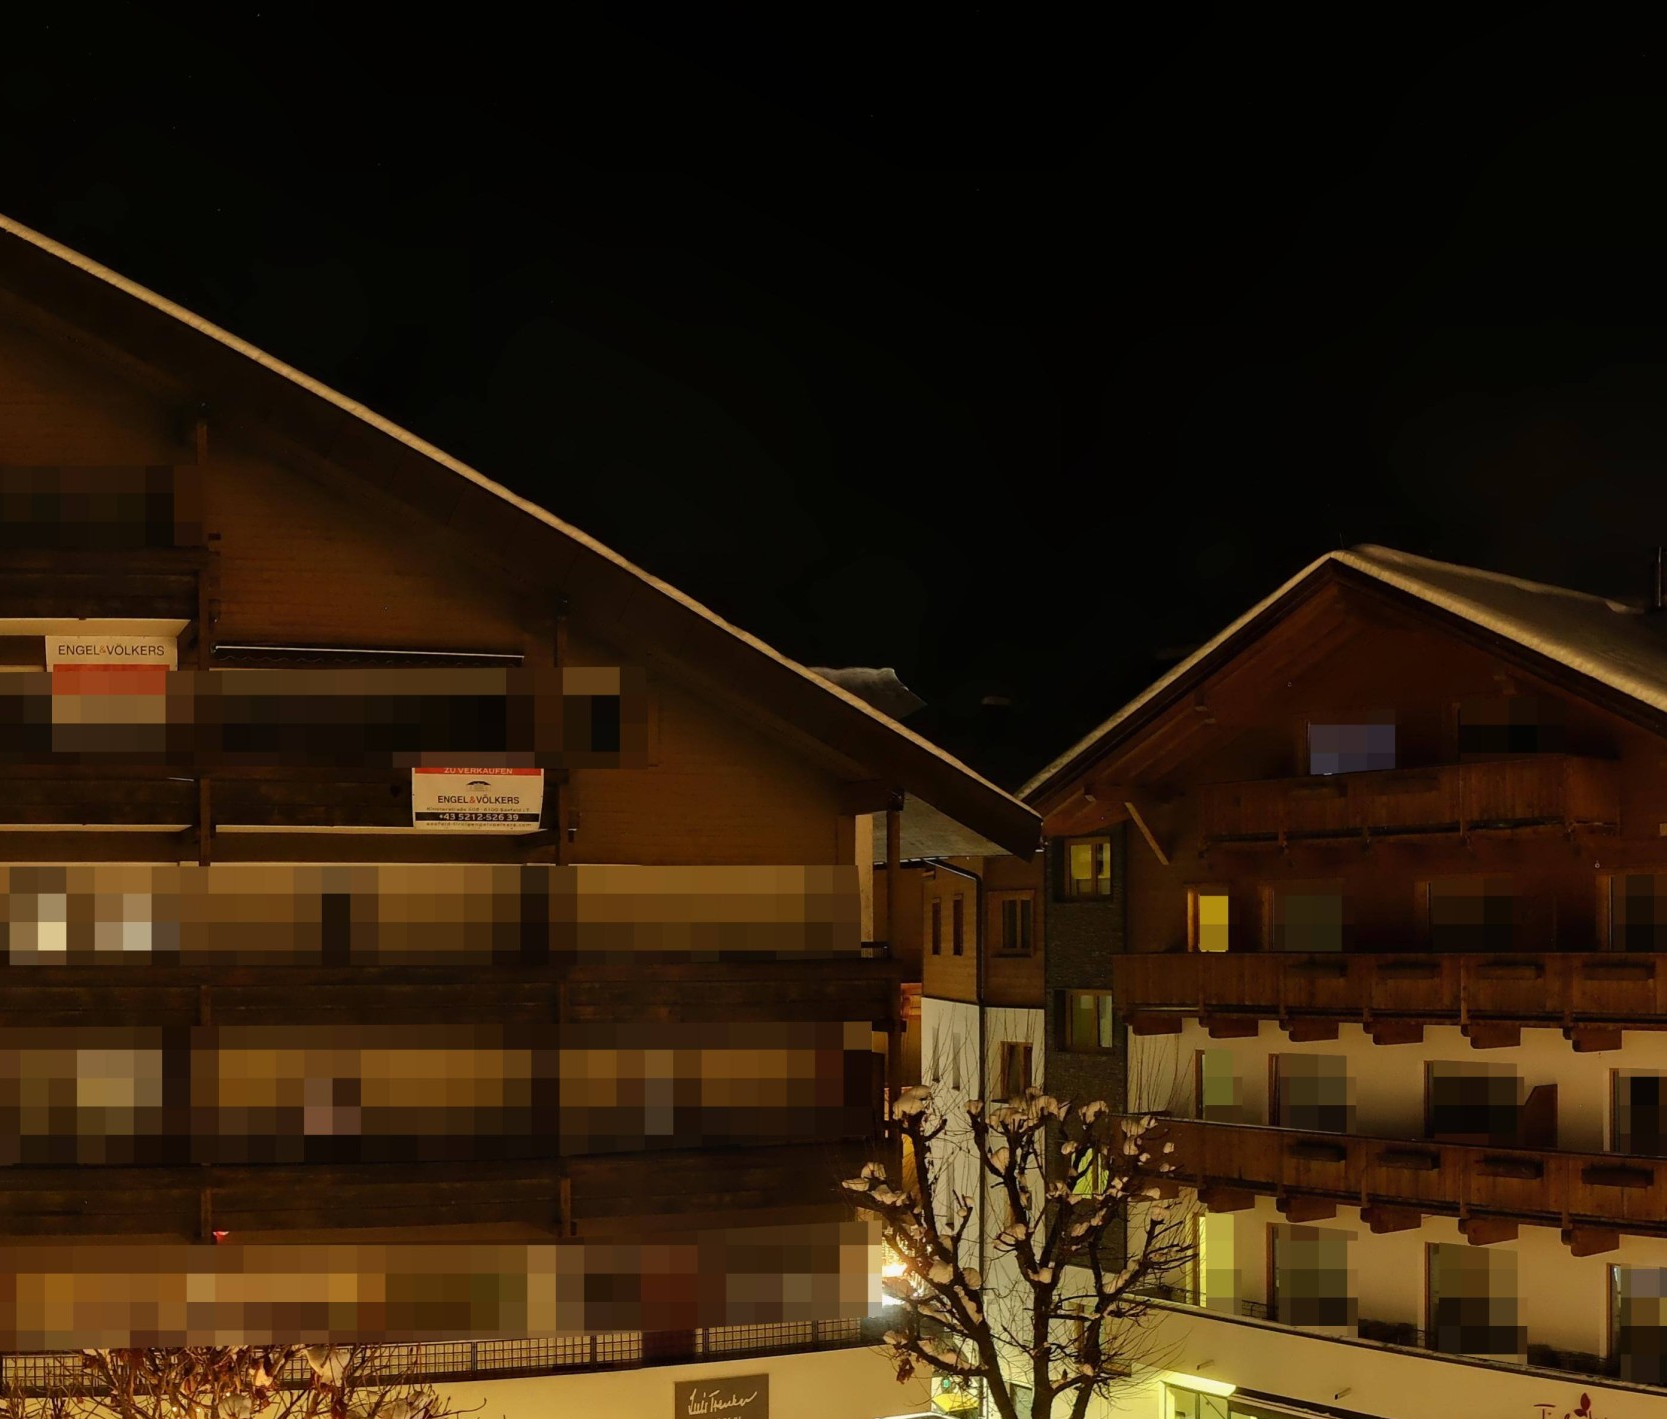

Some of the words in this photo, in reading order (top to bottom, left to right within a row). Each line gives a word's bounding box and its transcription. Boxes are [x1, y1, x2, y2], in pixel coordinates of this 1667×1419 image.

[58, 644, 165, 656] ENGEL&VÖLKERS
[459, 767, 513, 775] VERKAUFEN
[437, 794, 520, 805] ENGEL&VÖLKERS
[458, 813, 505, 821] 5212-526
